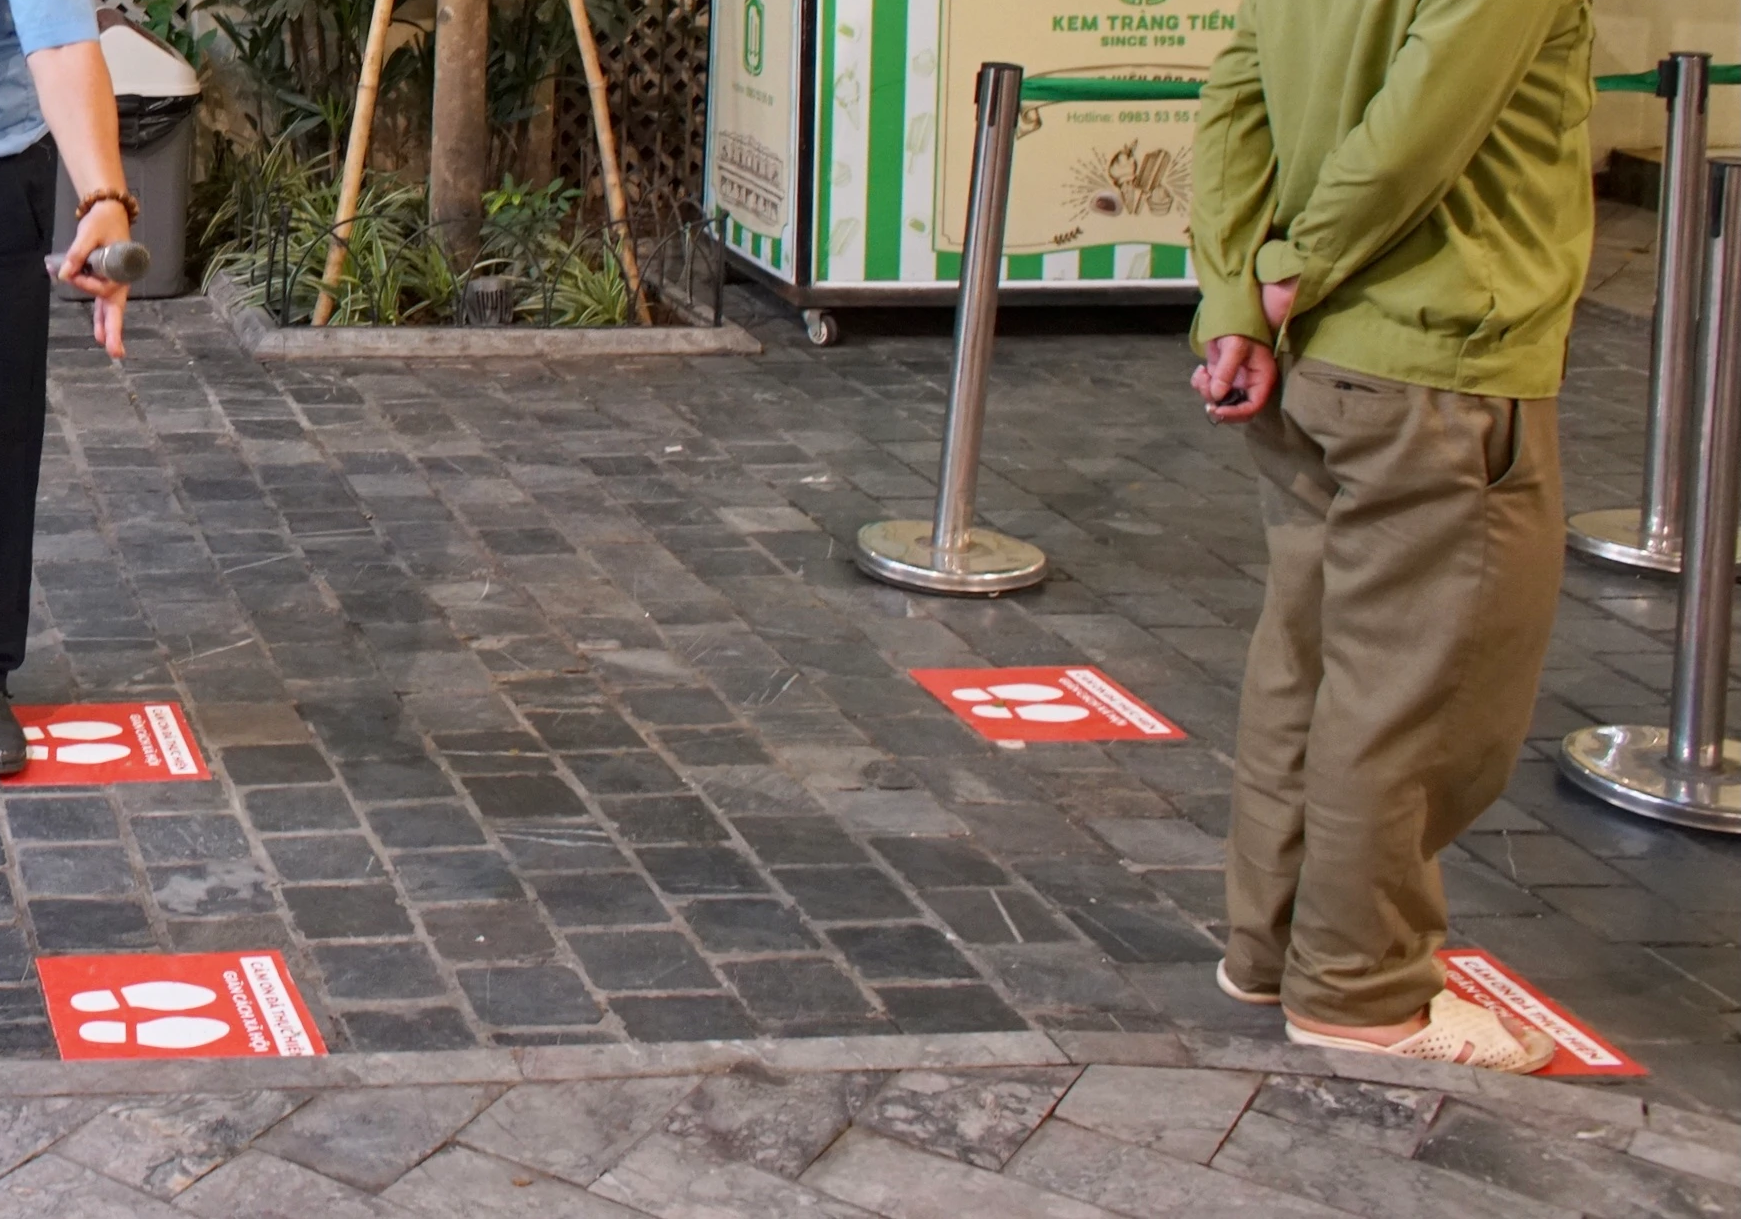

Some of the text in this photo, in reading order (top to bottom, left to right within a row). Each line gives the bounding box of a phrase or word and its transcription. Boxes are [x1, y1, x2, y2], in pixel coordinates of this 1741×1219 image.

[1052, 15, 1099, 32] KEM
[1100, 35, 1186, 47] SINCE 1958
[1118, 110, 1150, 123] 0983
